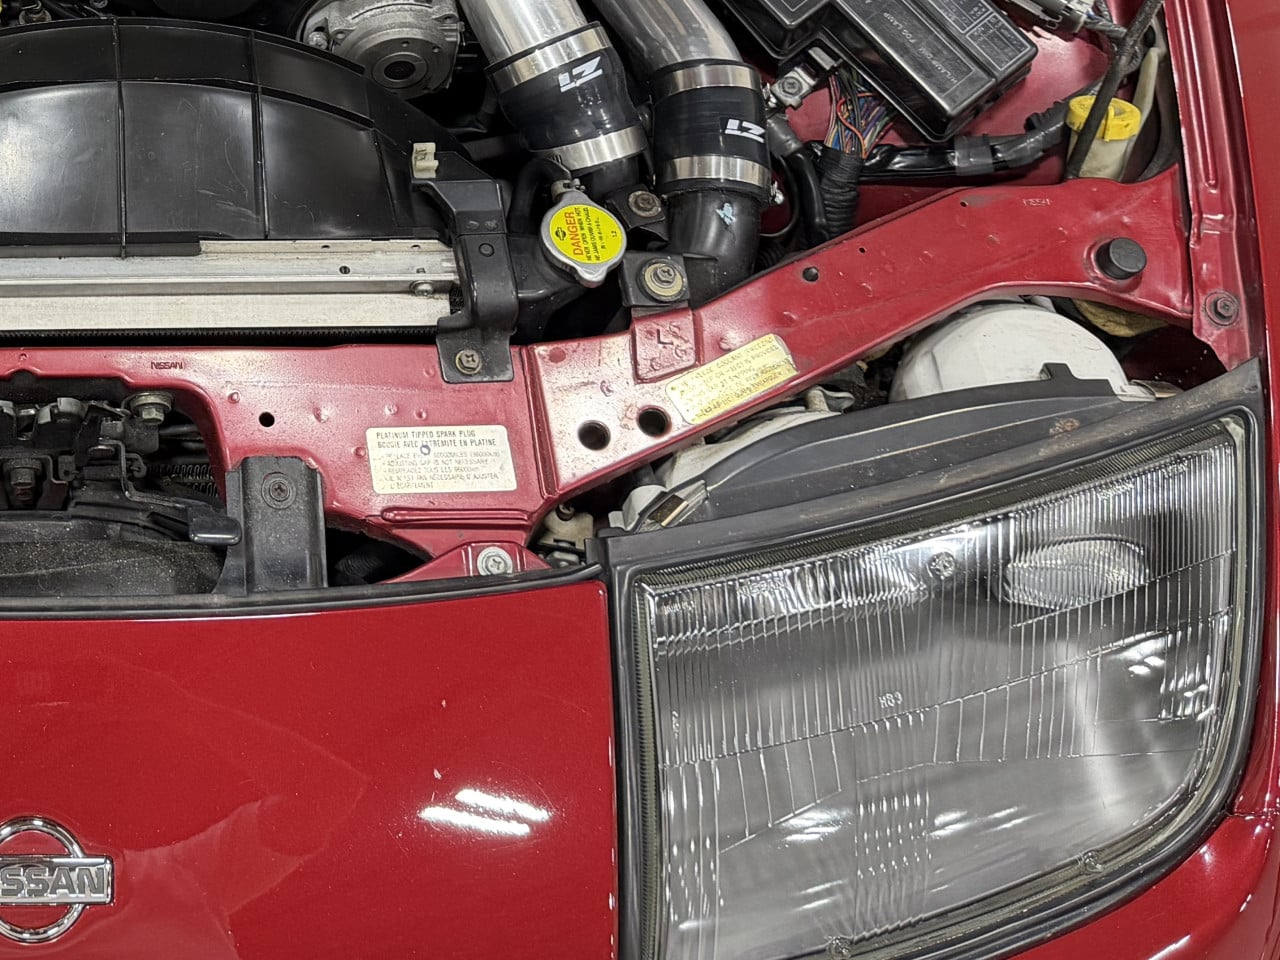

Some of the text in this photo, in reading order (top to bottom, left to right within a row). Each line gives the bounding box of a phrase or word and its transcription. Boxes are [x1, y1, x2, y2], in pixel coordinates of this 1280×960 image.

[882, 10, 917, 44] FOG LAMP
[931, 57, 960, 84] H/LAMP
[564, 211, 584, 256] DANGER
[584, 247, 592, 261] NEVER
[150, 361, 183, 370] NISSAN
[436, 430, 456, 438] SPARK
[470, 438, 496, 446] PLATINE
